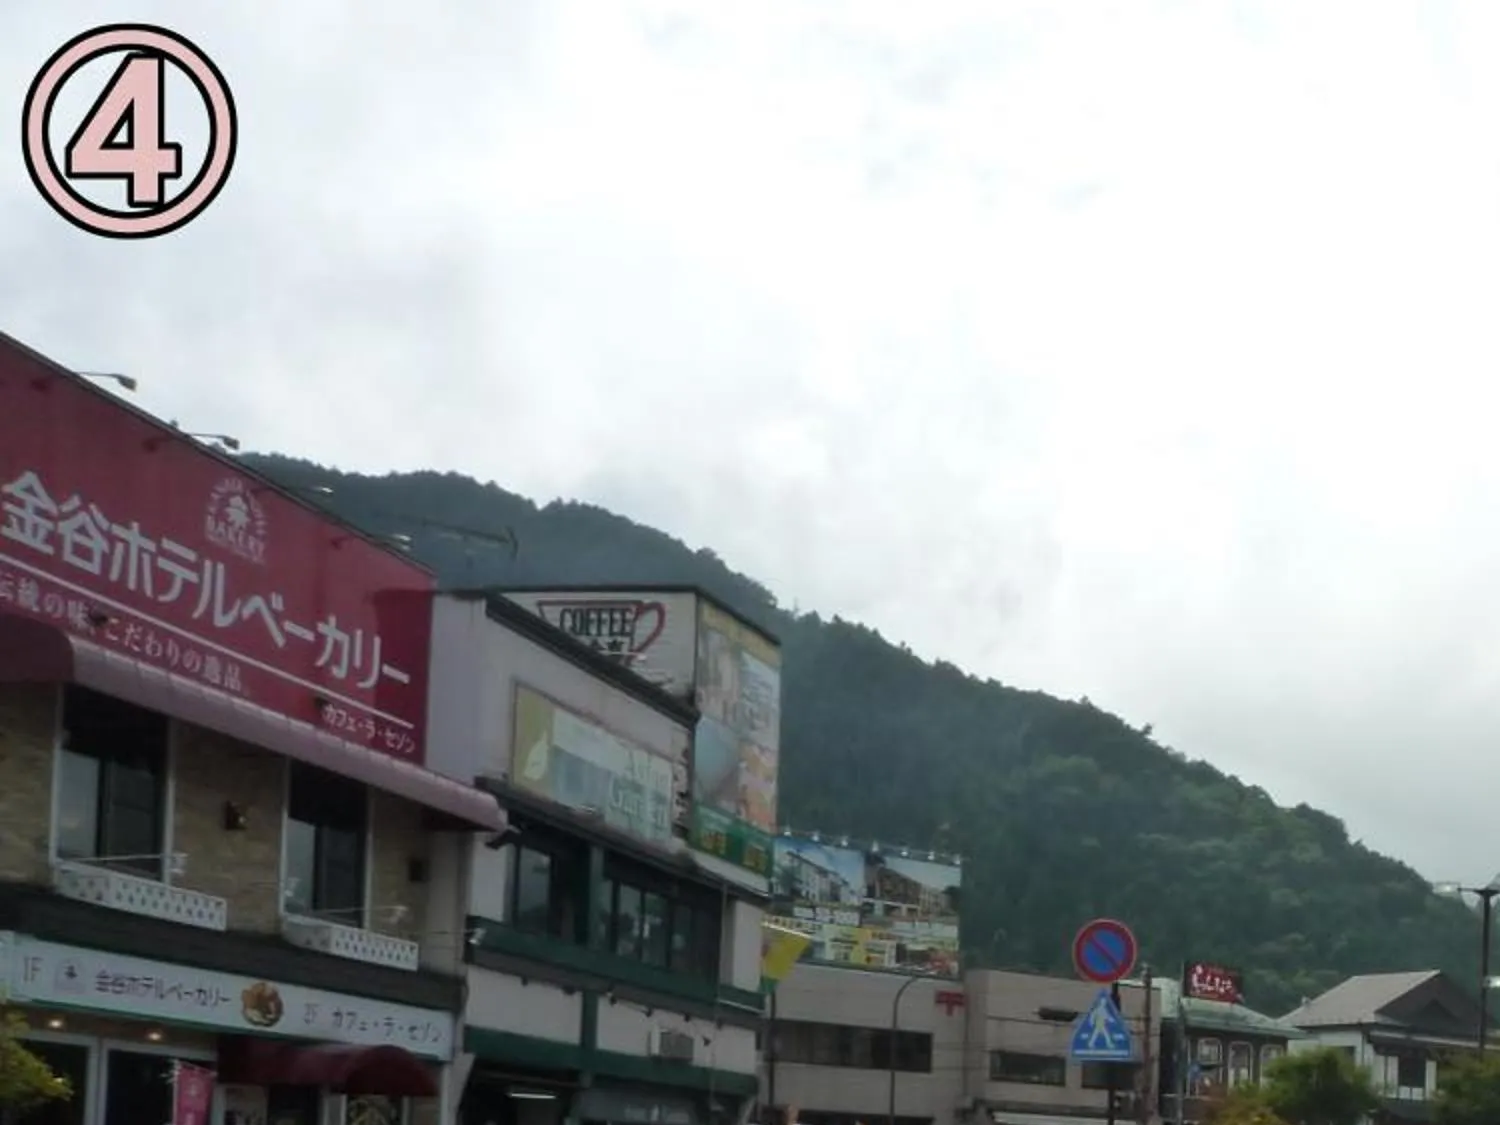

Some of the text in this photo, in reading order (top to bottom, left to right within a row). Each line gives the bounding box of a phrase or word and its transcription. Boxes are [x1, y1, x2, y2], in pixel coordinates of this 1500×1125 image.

[2, 470, 410, 690] 金谷ホテルベーカリー
[559, 607, 634, 638] COFFEE
